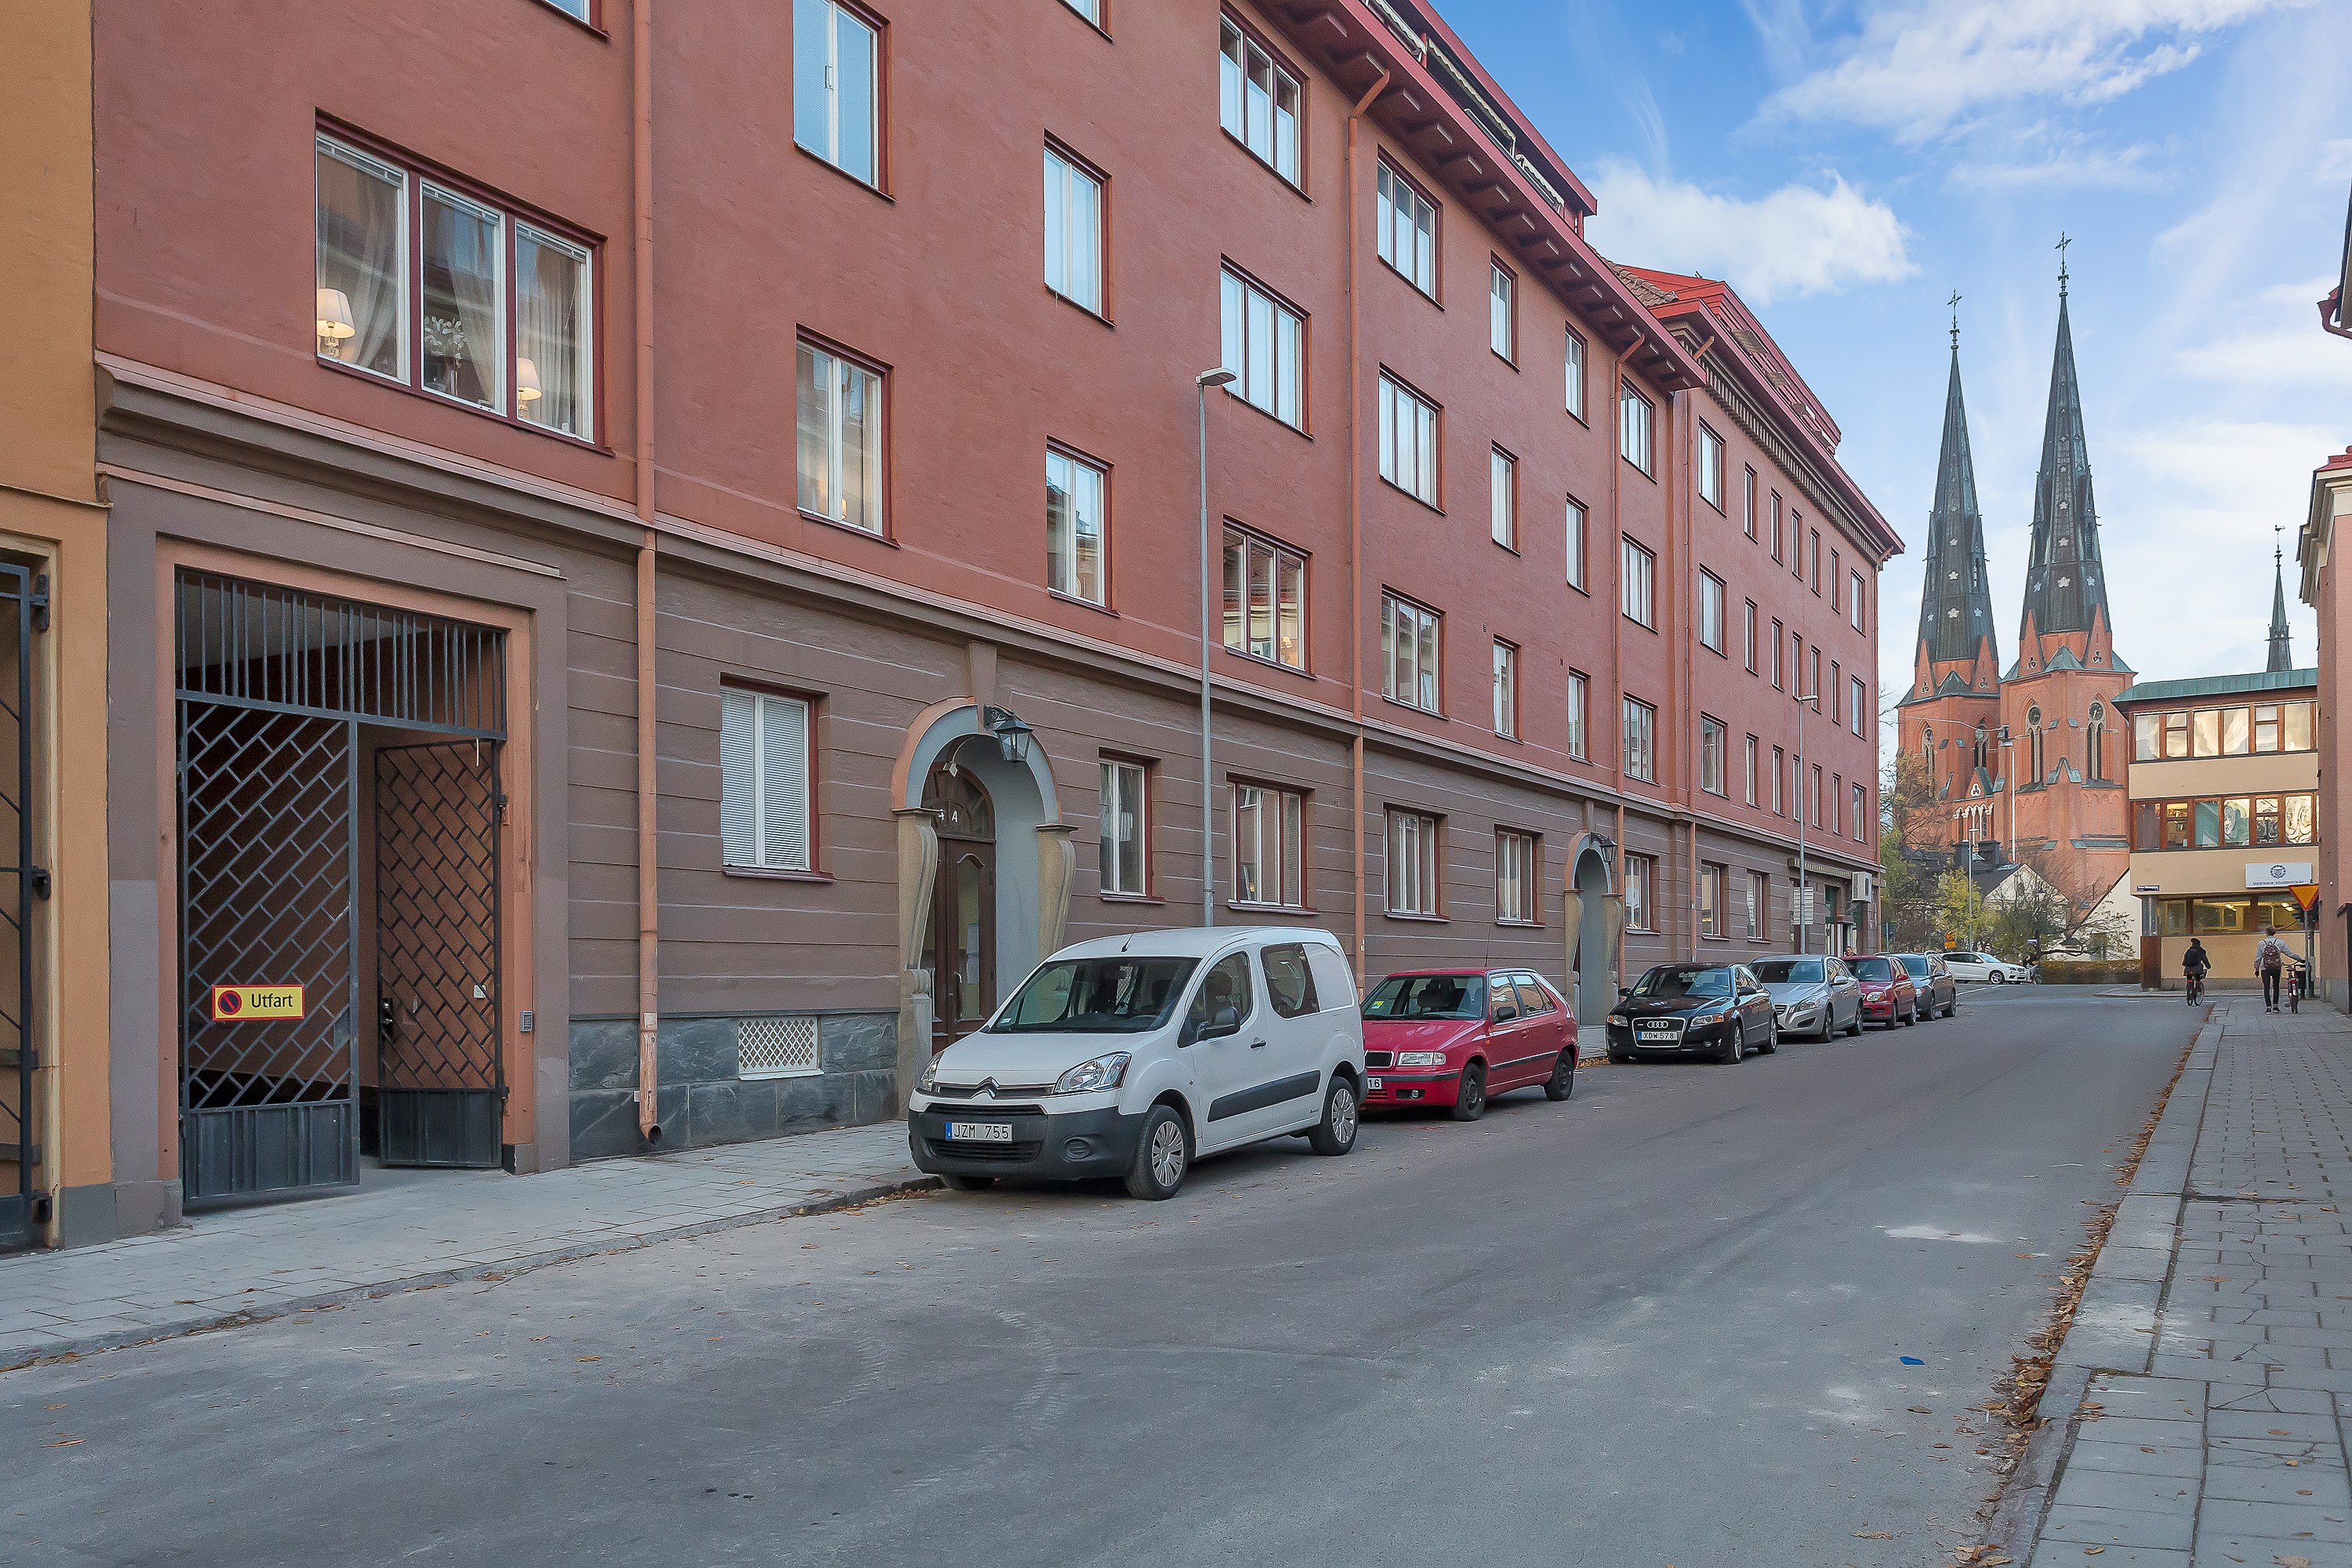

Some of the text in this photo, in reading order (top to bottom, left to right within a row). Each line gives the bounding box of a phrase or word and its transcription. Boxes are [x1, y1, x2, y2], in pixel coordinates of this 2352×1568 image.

[951, 810, 958, 822] A
[251, 993, 293, 1008] Utfart
[1368, 1079, 1380, 1088] 16
[953, 1124, 1009, 1139] JZM 755
